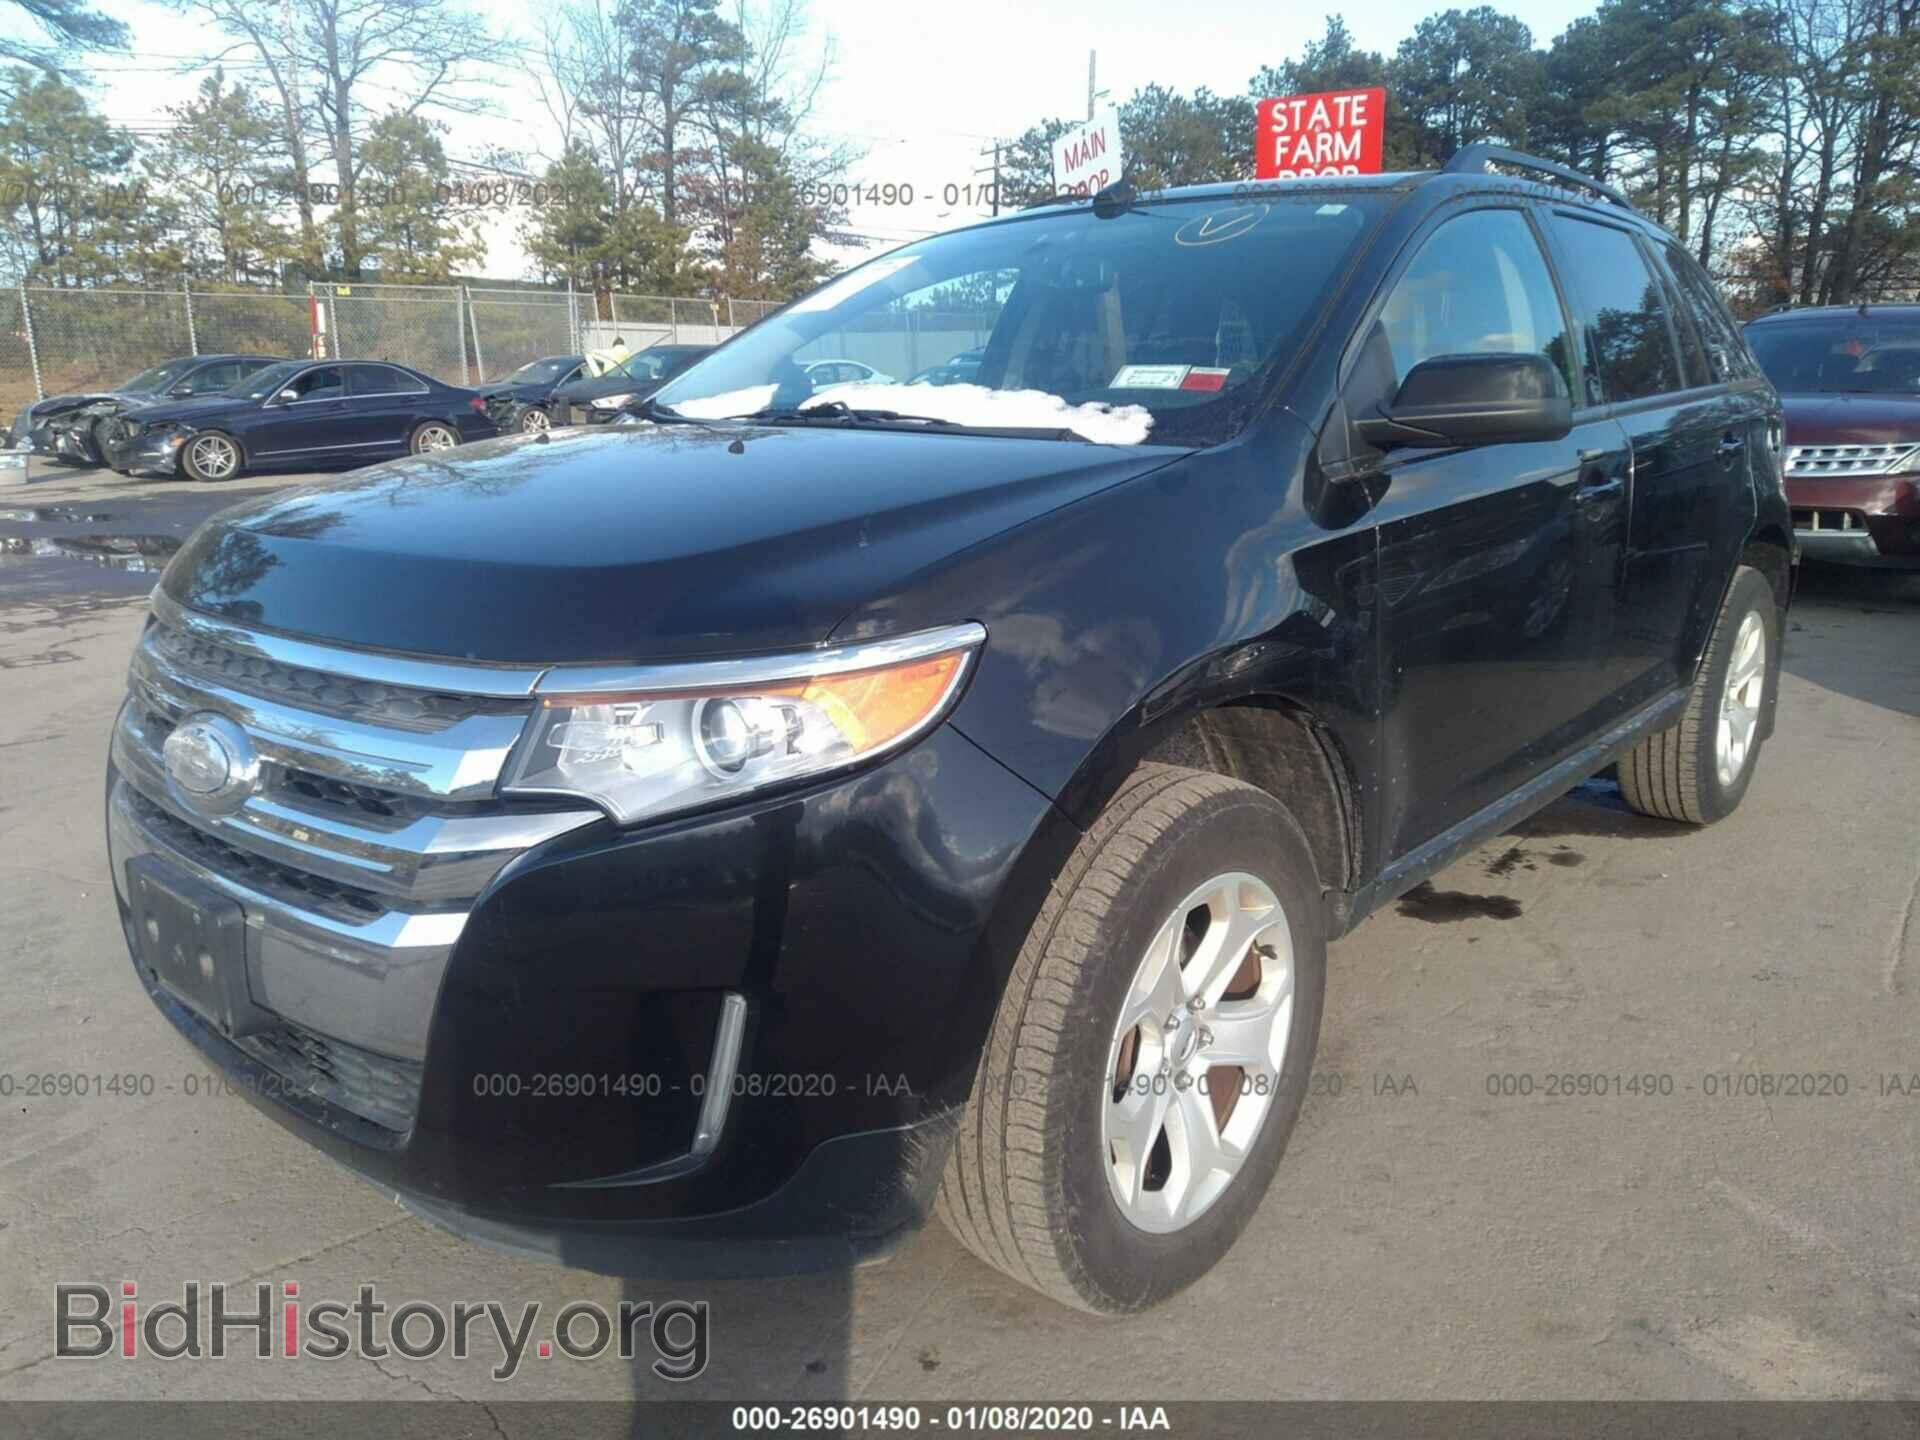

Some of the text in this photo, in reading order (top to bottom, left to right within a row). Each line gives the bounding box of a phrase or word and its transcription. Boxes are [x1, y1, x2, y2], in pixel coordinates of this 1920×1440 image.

[1271, 94, 1368, 132] STATE
[1064, 126, 1106, 173] MAIN
[1275, 128, 1361, 167] FARM
